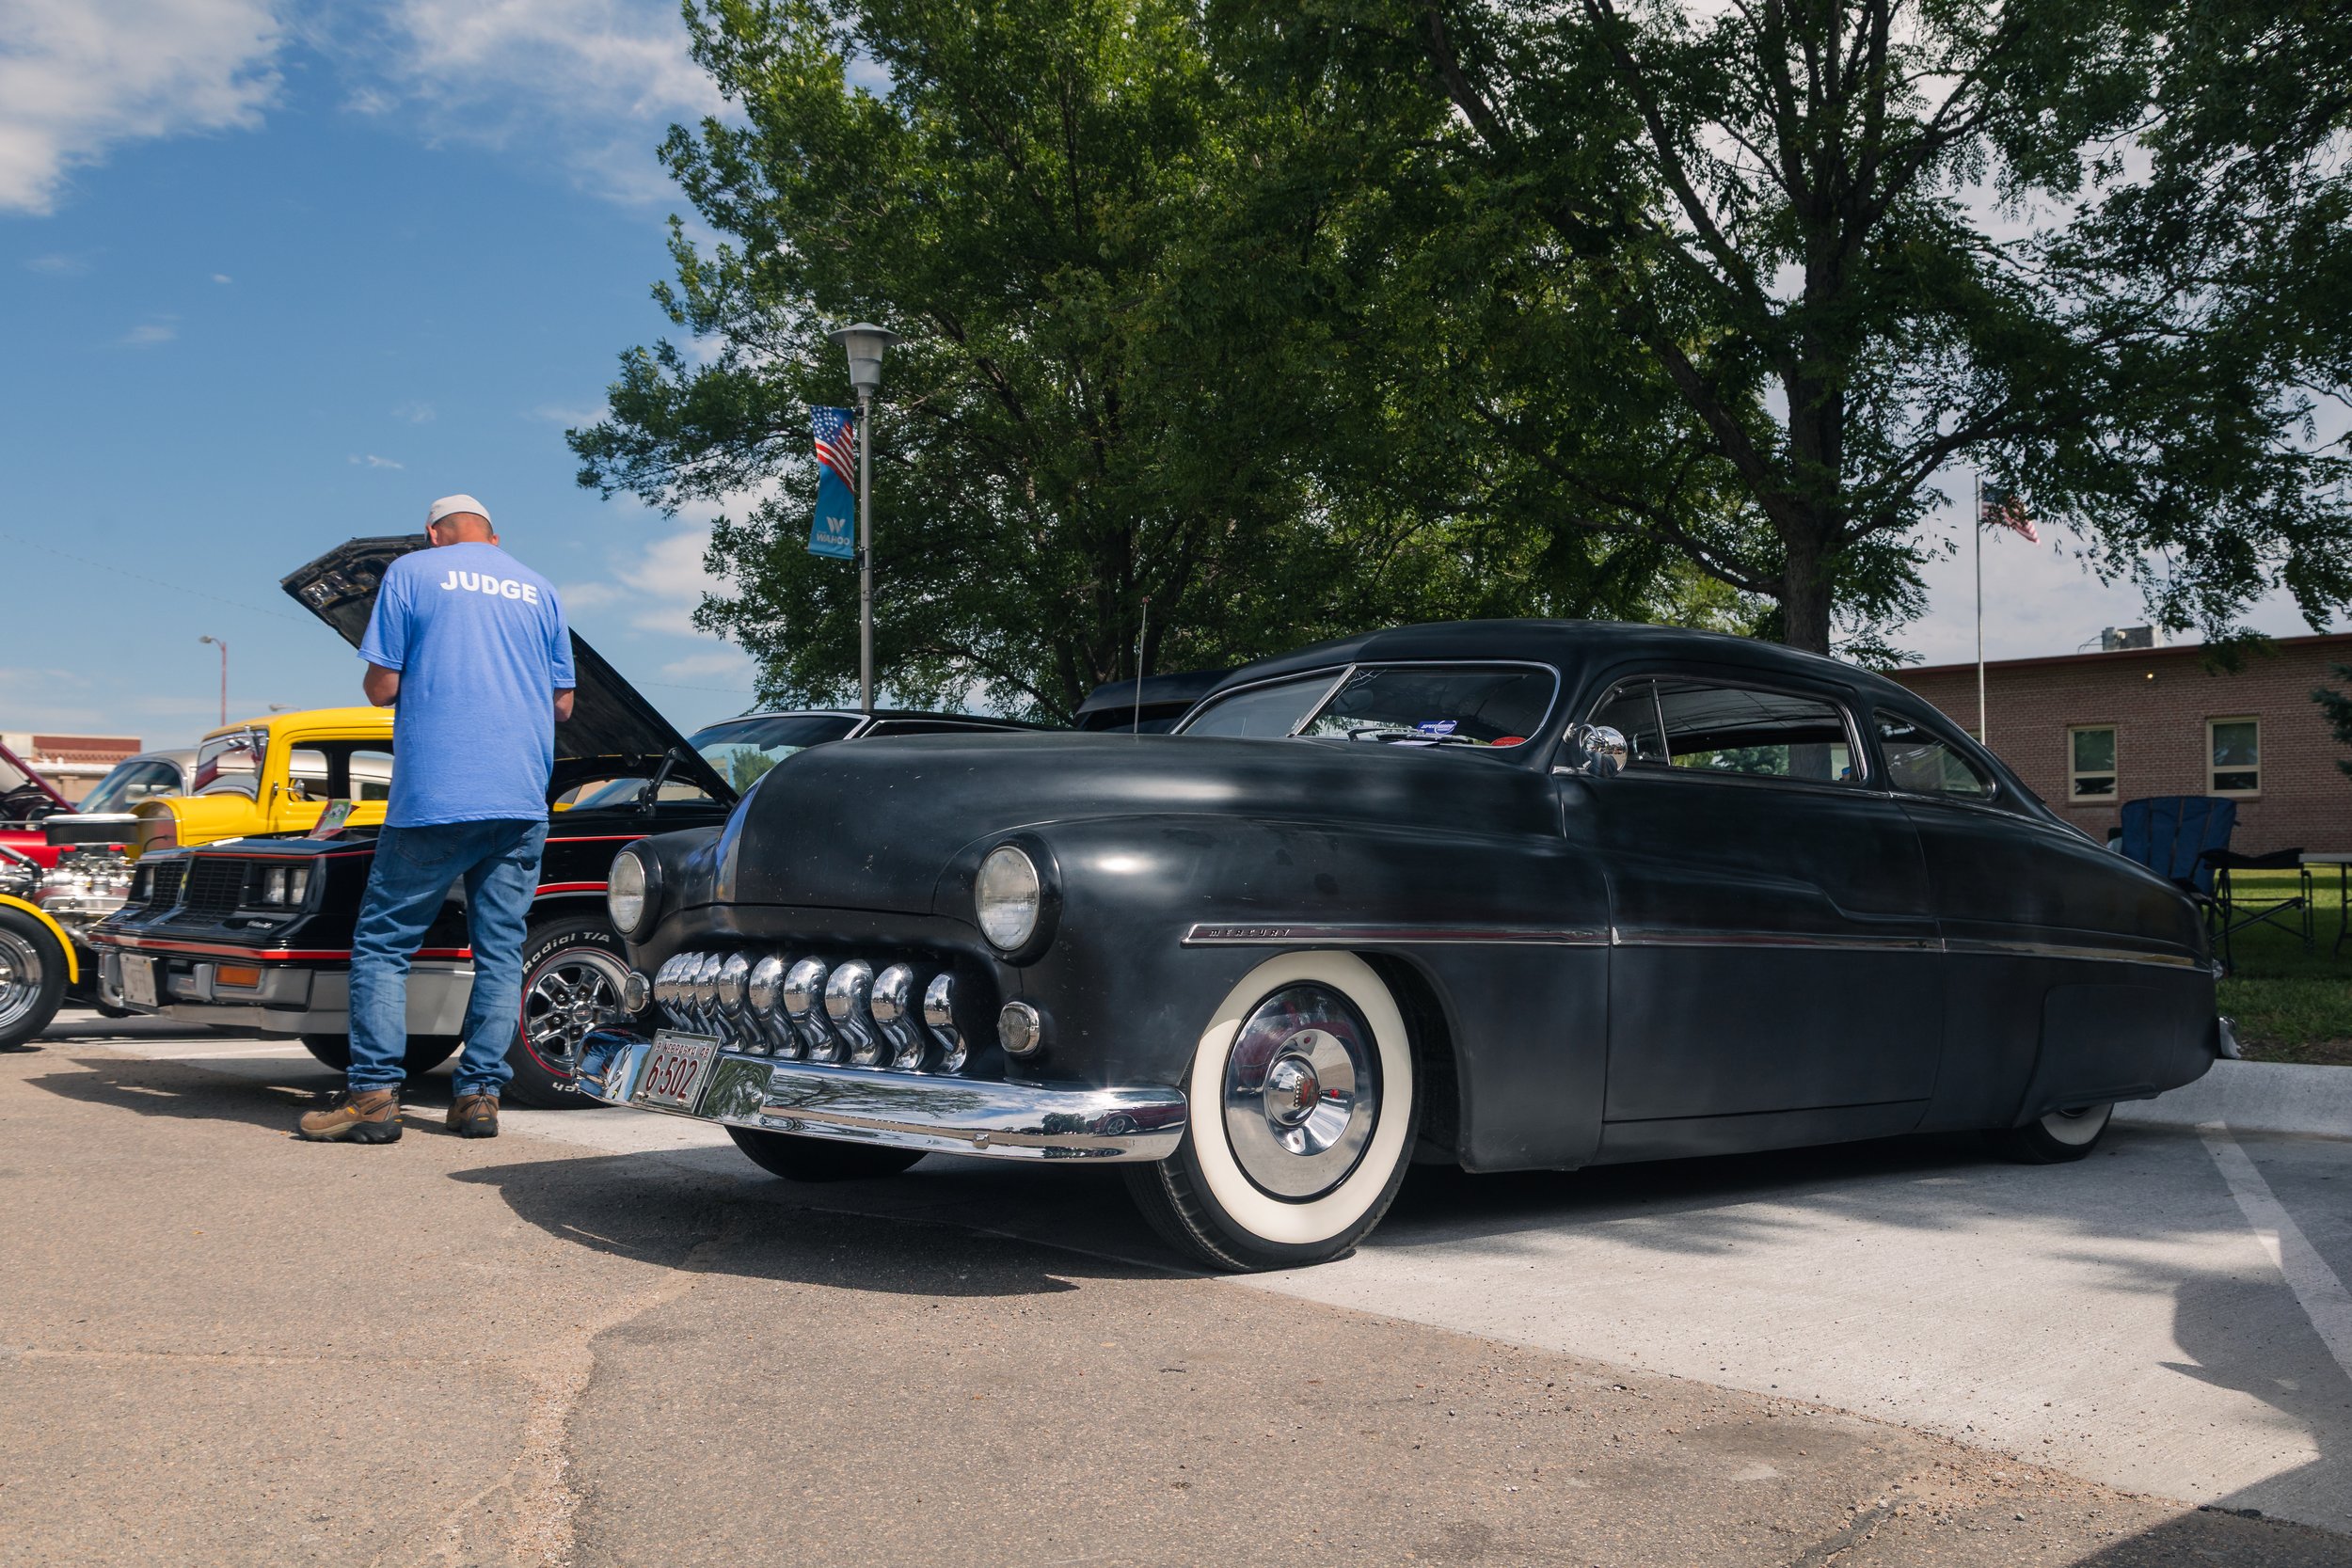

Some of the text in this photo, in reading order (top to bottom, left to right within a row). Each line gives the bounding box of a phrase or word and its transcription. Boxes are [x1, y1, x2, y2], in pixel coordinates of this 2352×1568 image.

[816, 532, 850, 546] WAHOO
[440, 570, 538, 605] JUDGE
[1209, 928, 1290, 937] MERCURY
[522, 932, 611, 974] Radial T/A
[663, 1042, 698, 1056] NEBRASKA
